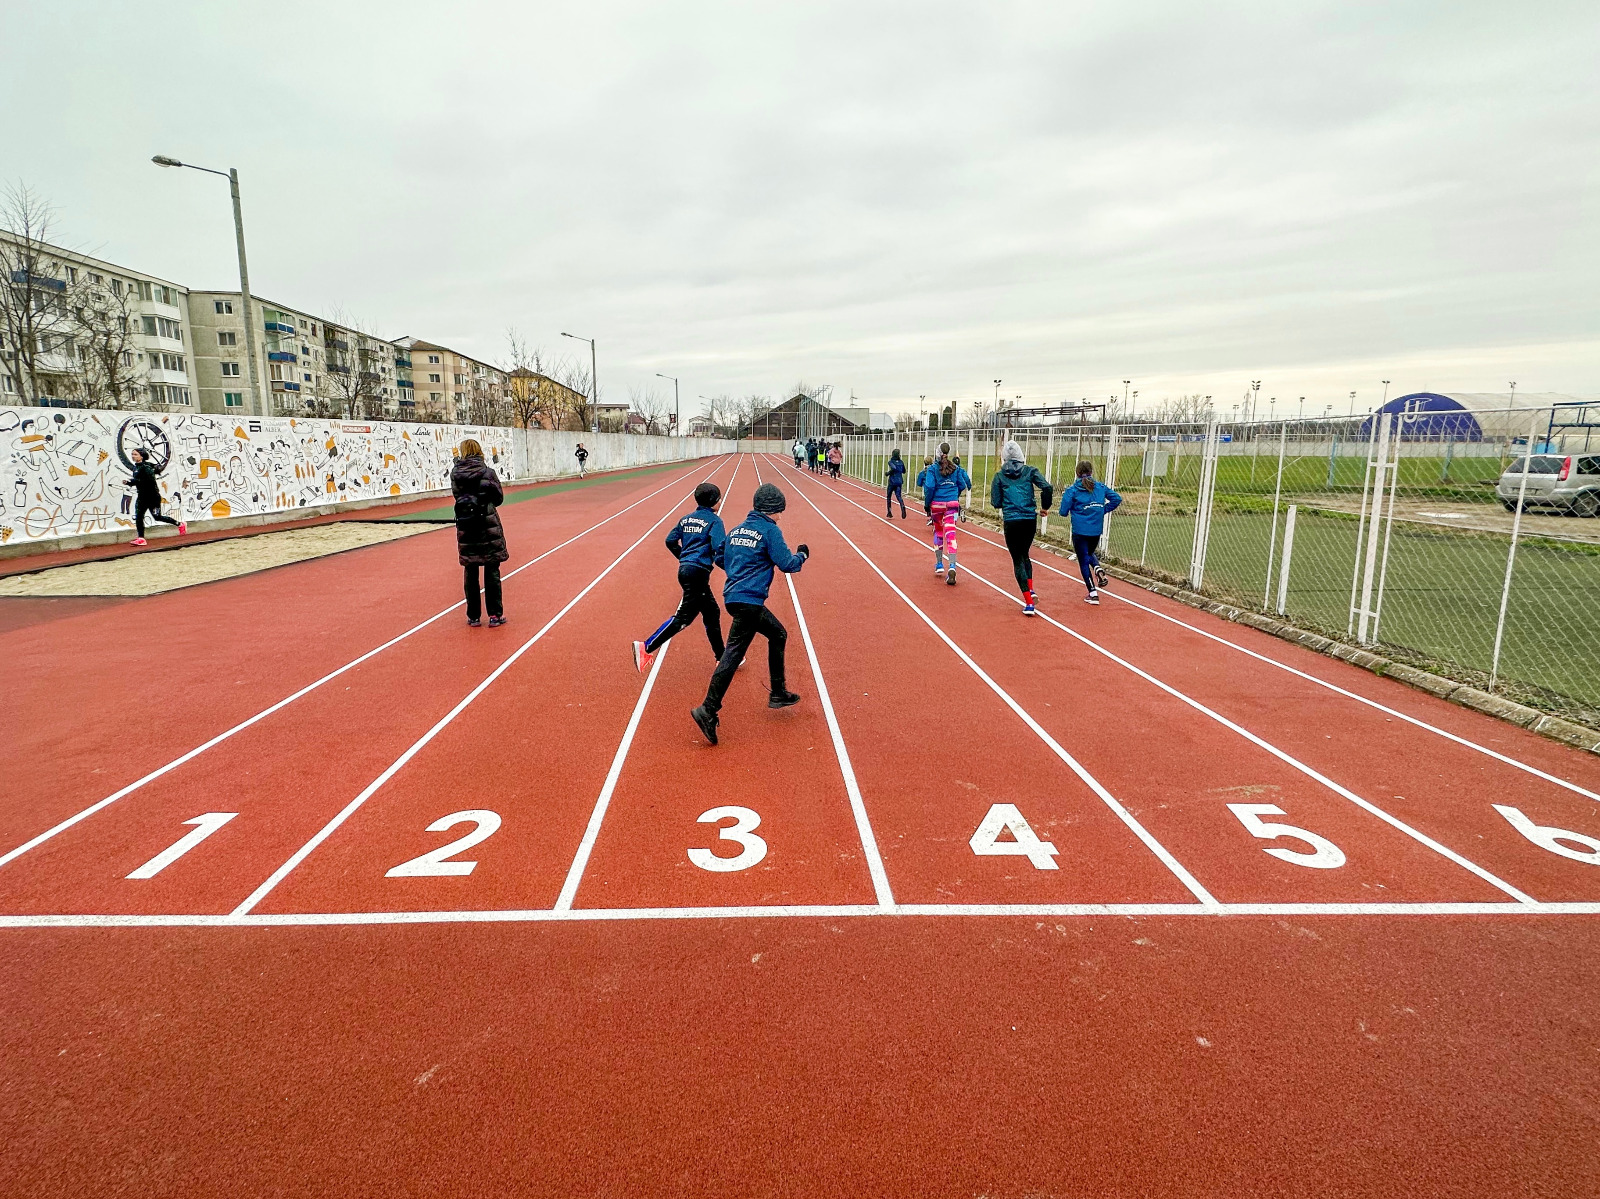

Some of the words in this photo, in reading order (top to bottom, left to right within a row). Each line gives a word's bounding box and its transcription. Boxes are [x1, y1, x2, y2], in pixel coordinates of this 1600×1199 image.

[125, 813, 239, 879] 1
[384, 810, 502, 877] 2
[687, 806, 767, 872] 3
[969, 804, 1059, 870] 4
[1226, 804, 1346, 868] 5
[1492, 803, 1600, 865] 6
